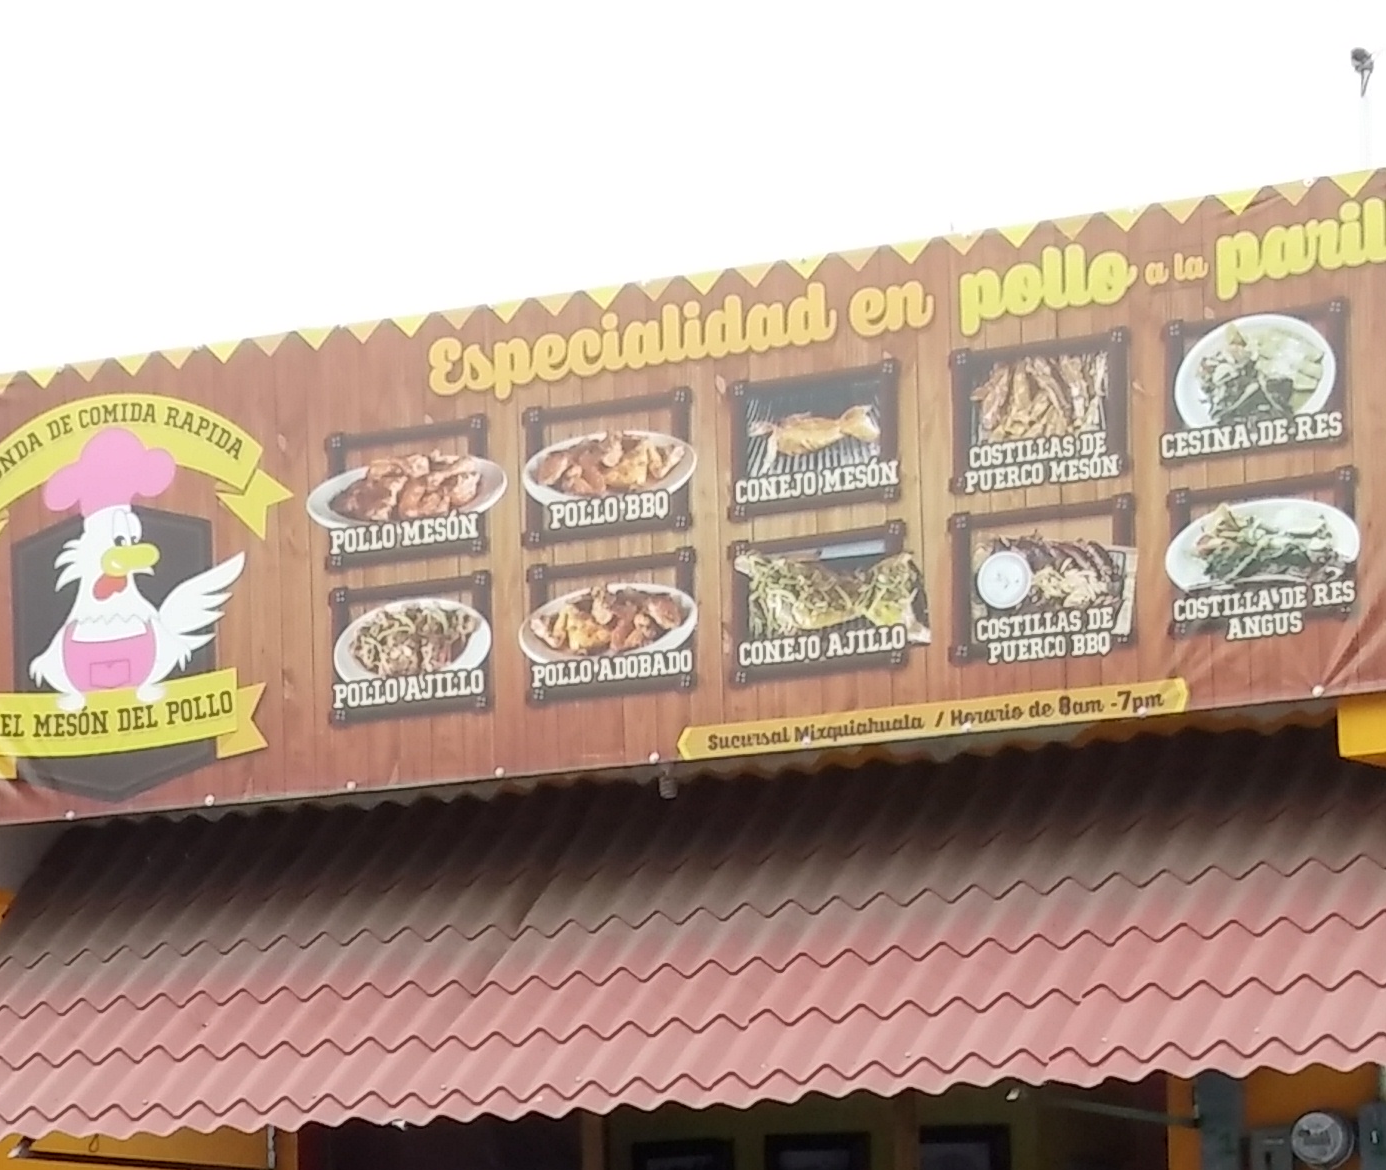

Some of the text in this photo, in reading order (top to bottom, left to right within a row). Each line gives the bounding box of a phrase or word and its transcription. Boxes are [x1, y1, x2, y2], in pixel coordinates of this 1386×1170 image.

[429, 281, 836, 400] Especialidad
[849, 280, 934, 336] en
[960, 243, 1137, 335] pollo
[1145, 262, 1169, 286] a
[1174, 252, 1209, 282] la
[48, 413, 74, 439] DE
[79, 402, 156, 428] COMIDA
[163, 406, 245, 461] RAPIDA
[969, 431, 1107, 468] COSTILLAS DE
[1161, 411, 1343, 459] CESINA DE RES
[735, 460, 899, 503] CONEJO MESÓN
[965, 450, 1119, 493] PUERCO MESÓN
[330, 508, 479, 554] POLLO MESÓN
[549, 490, 670, 530] POLLO BBQ
[977, 605, 1114, 641] COSTILLAS DE
[1173, 580, 1356, 623] COSTILLA DE RES
[739, 624, 907, 667] CONEJO AJILLO
[1225, 612, 1303, 641] ANGUS
[531, 649, 693, 689] POLLO ADOBADO
[987, 632, 1111, 665] PUERCO BBQ
[332, 669, 485, 709] POLLO AJILLO
[0, 689, 234, 738] EL MESÓN DEL POLLO
[708, 727, 790, 751] Sucursal
[794, 714, 924, 742] Mixquiahuala
[950, 702, 1025, 727] Horario
[1029, 700, 1054, 718] de
